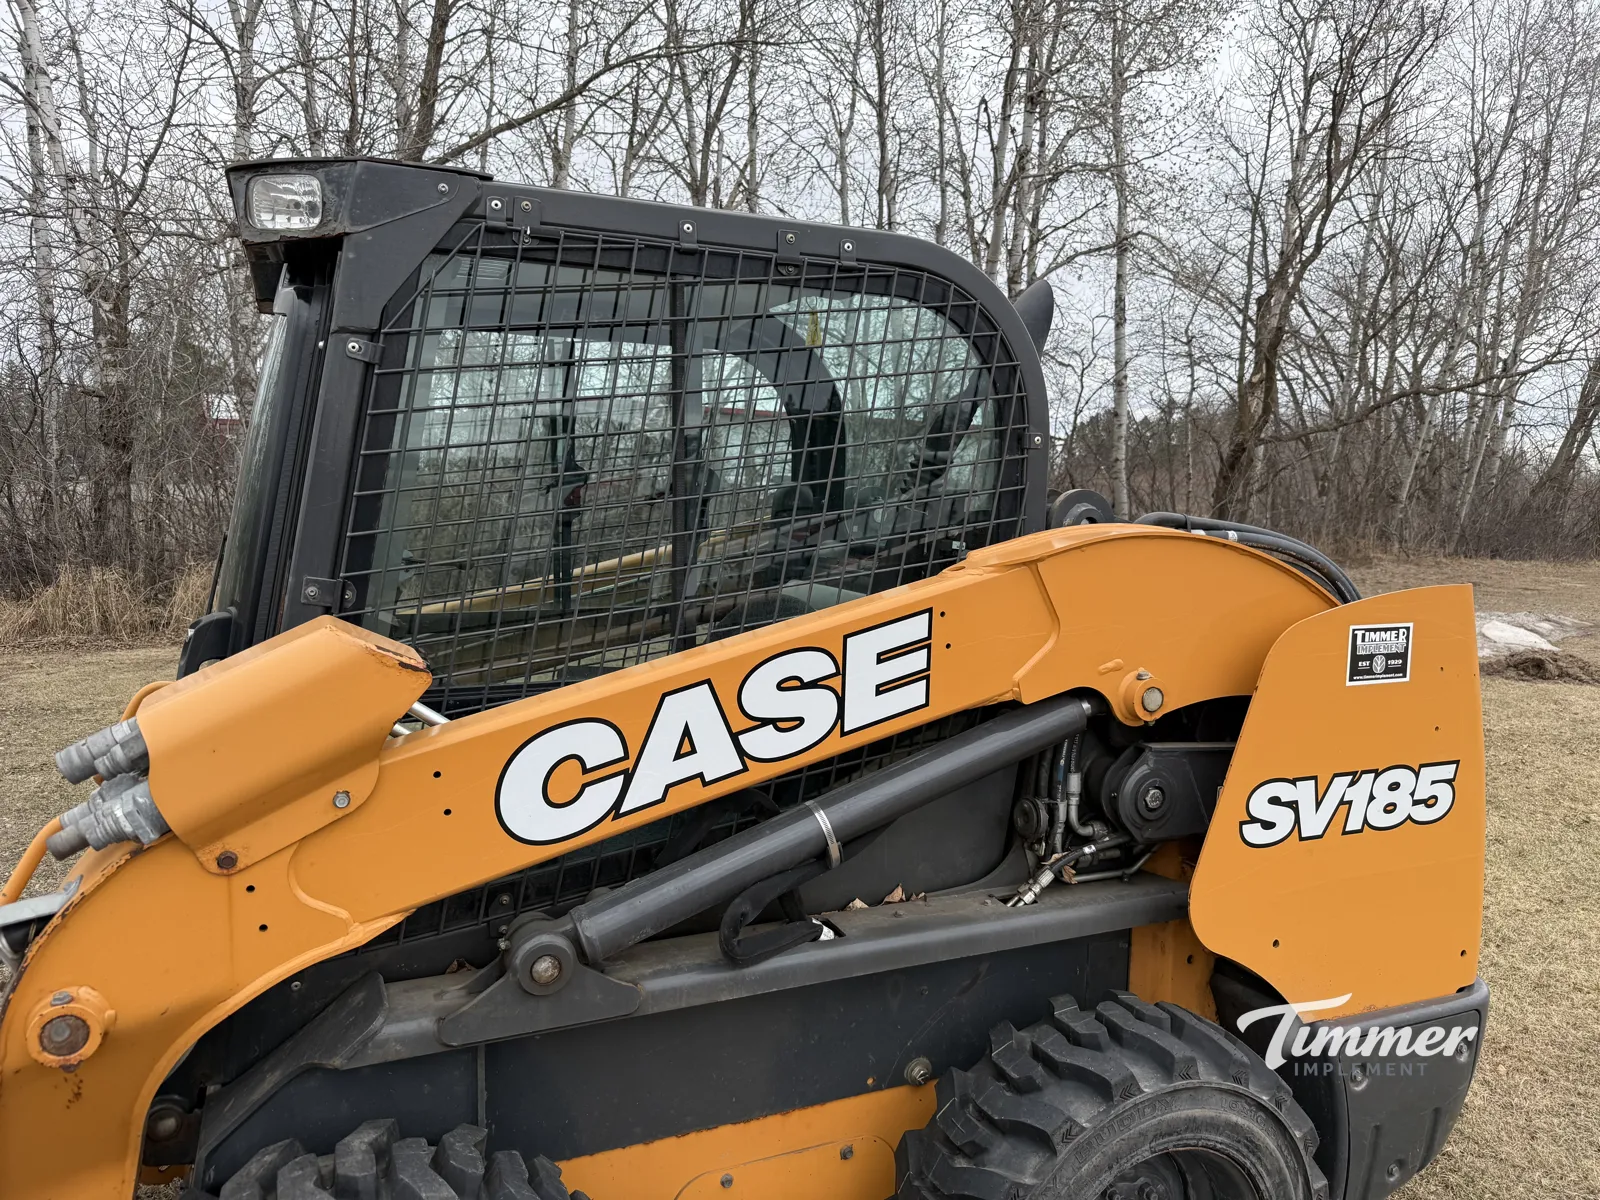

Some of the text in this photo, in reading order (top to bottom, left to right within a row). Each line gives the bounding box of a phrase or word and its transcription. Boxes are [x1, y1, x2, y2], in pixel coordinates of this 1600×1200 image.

[1354, 628, 1407, 644] TIMMER
[1357, 643, 1406, 654] IMPLEMENT
[494, 606, 933, 846] CASE
[1239, 759, 1461, 849] SV185
